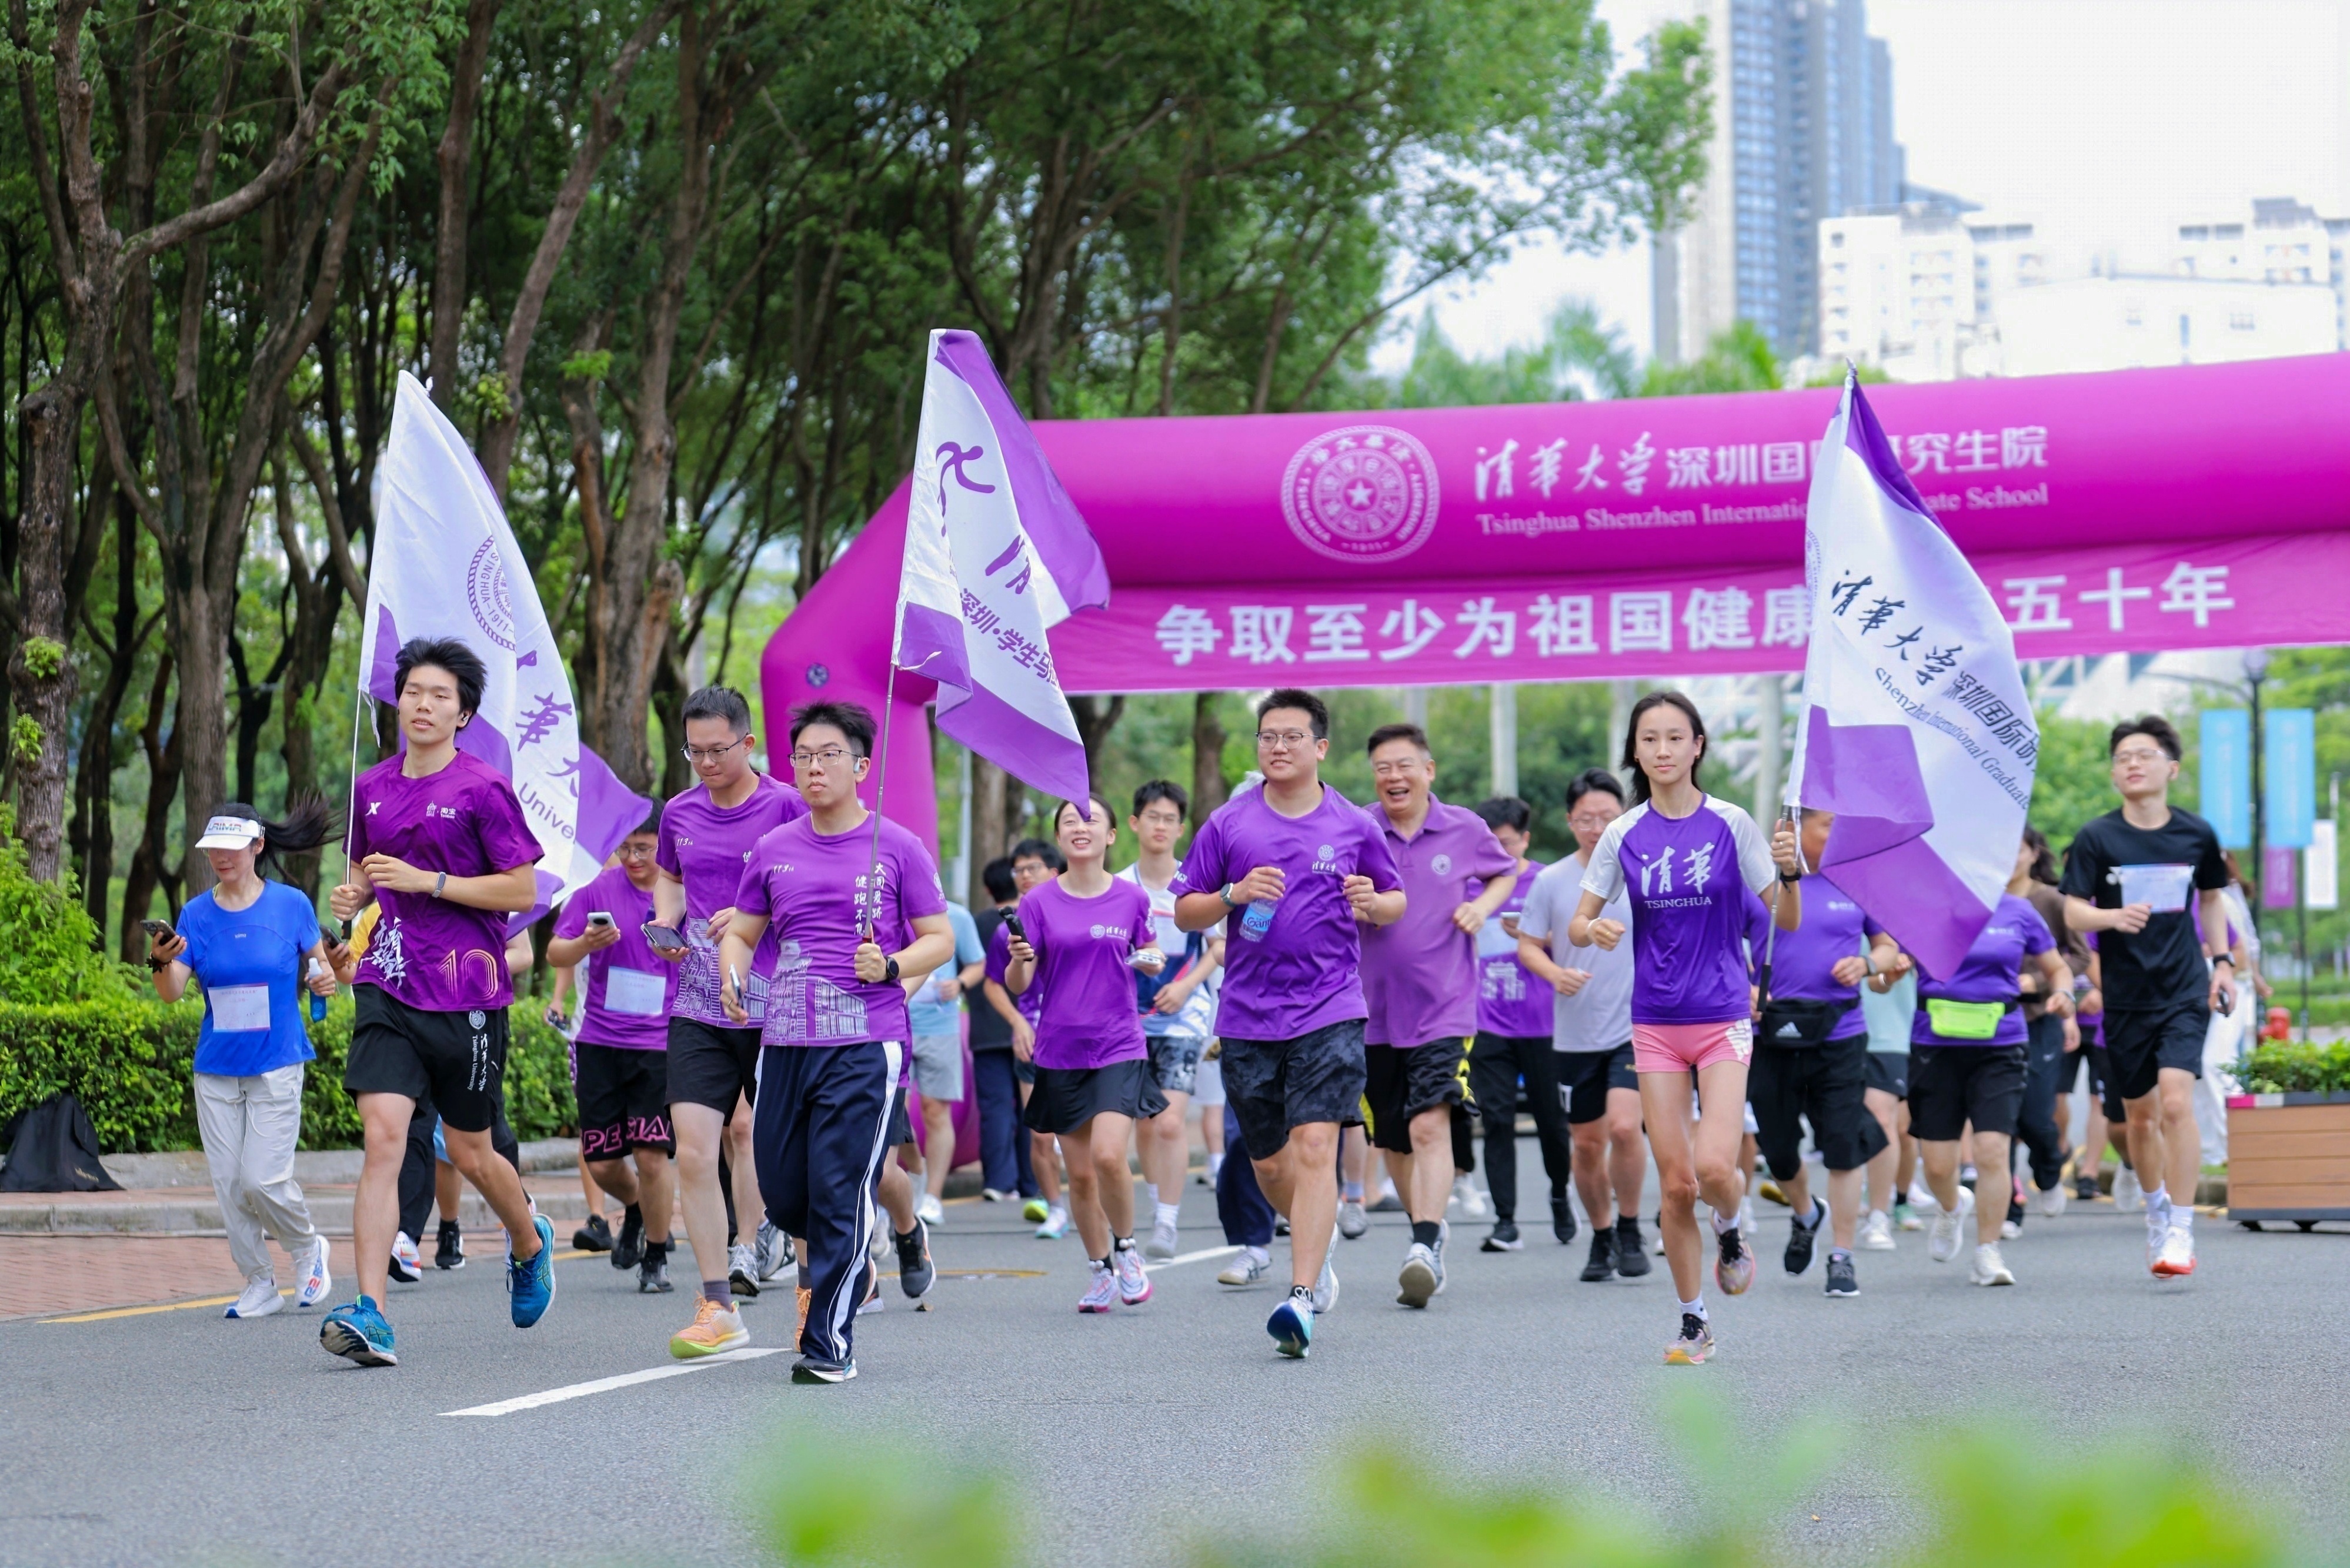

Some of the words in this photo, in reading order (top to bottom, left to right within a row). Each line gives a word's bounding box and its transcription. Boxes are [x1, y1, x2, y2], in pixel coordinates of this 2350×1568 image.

[1474, 510, 1581, 539] Tsinghua
[1584, 505, 1697, 531] Shenzhen
[1965, 482, 2050, 511] School
[1154, 560, 2235, 666] 争取至少为祖国健康五十年
[1876, 667, 1931, 723] Shenzhen
[1927, 711, 1989, 759] International
[518, 782, 576, 841] Unive
[1644, 896, 1713, 909] TSINGHUA
[467, 1063, 478, 1091] University
